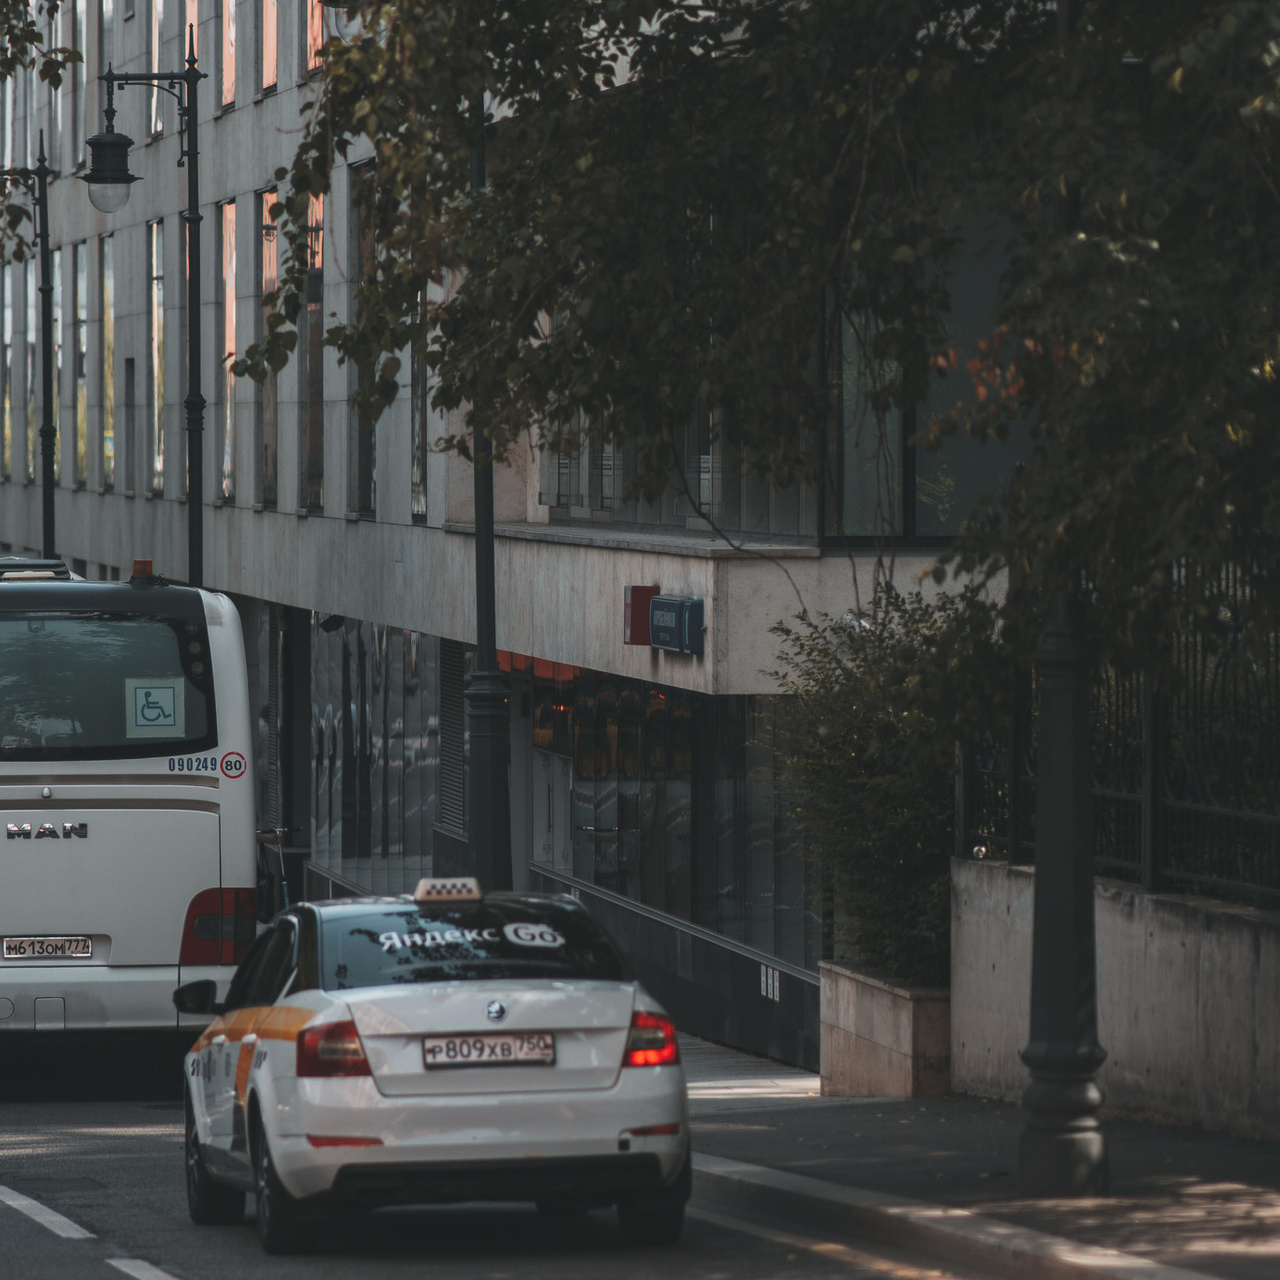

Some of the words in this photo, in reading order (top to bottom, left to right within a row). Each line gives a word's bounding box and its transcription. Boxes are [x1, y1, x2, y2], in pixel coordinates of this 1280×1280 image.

[168, 757, 217, 772] 090249
[224, 760, 242, 771] 80
[6, 823, 88, 840] MAN
[378, 927, 500, 951] Яндекс
[511, 924, 560, 945] Go
[8, 940, 64, 955] М613ОМ
[66, 939, 87, 951] 777
[431, 1039, 512, 1060] Р809ХВ
[516, 1034, 546, 1052] 750
